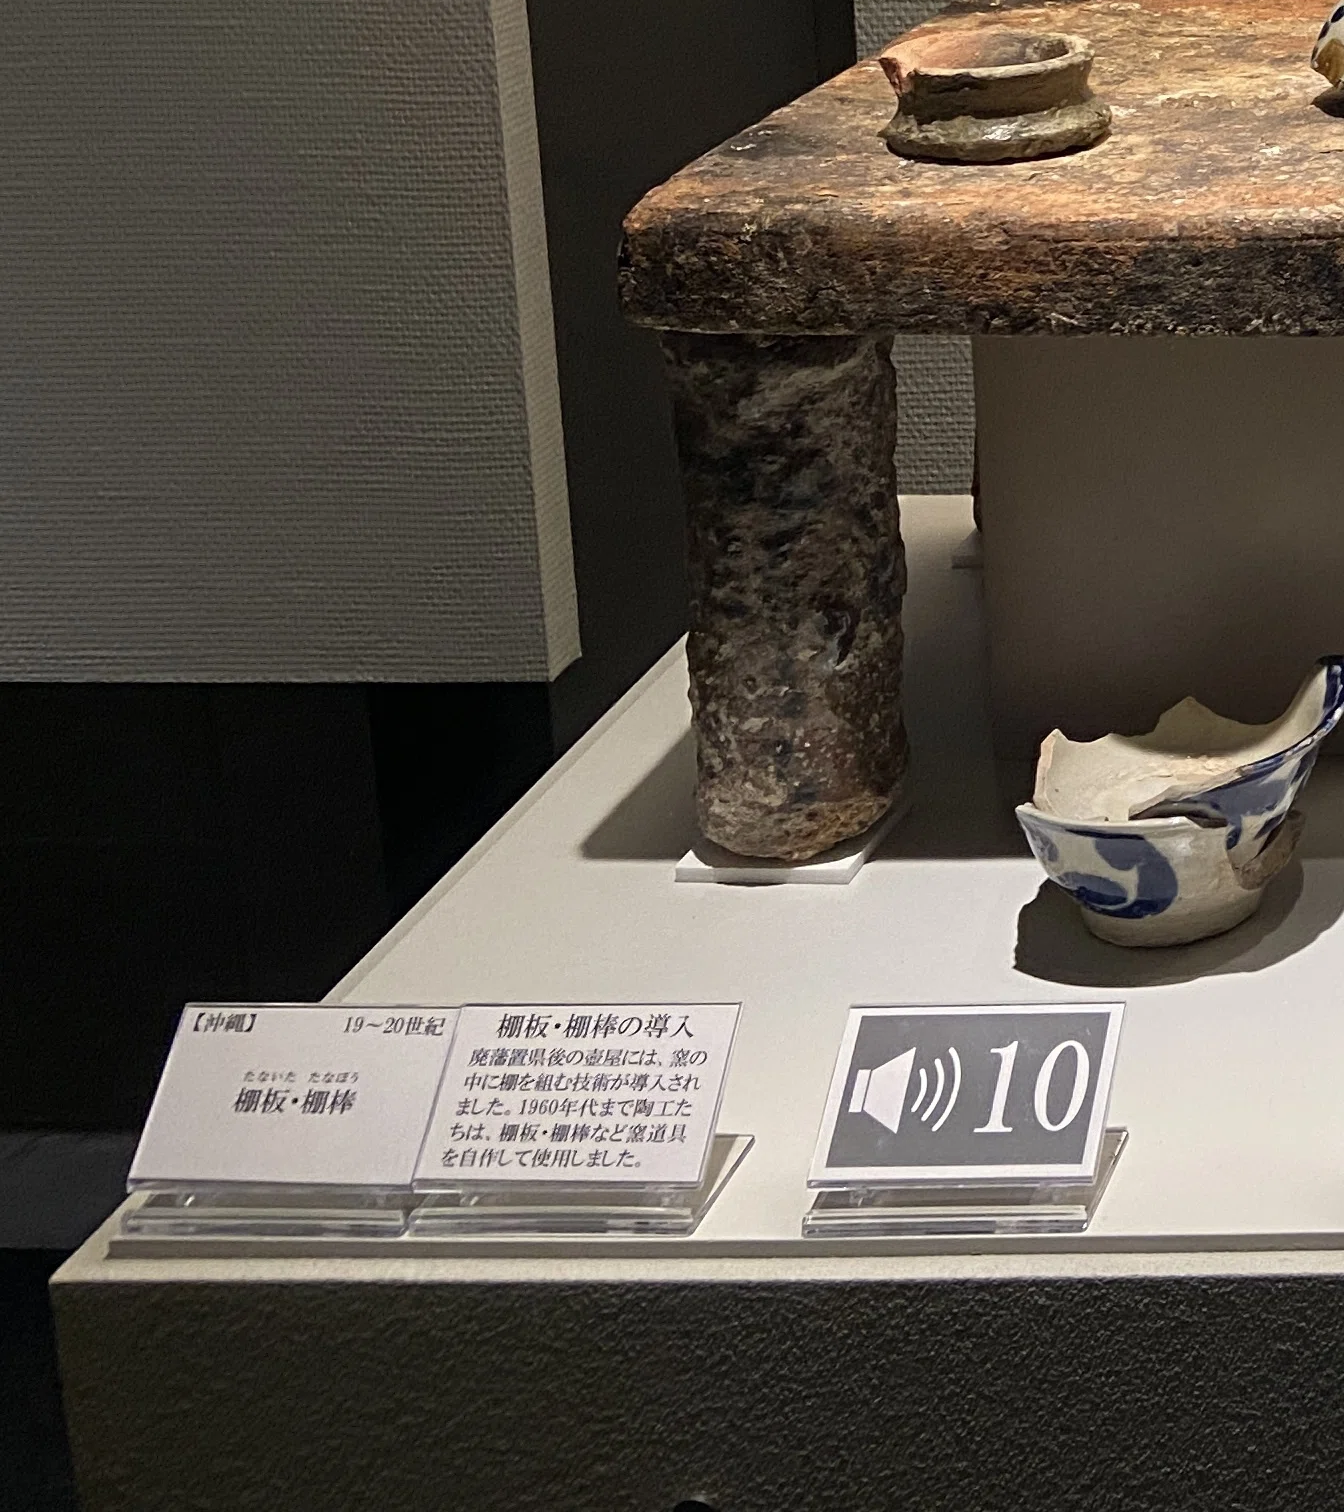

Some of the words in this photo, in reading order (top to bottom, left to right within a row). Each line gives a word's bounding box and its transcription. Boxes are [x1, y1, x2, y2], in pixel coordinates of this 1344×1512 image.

[973, 1039, 1090, 1133] 10
[441, 1147, 643, 1169] を自作して使用しました。
